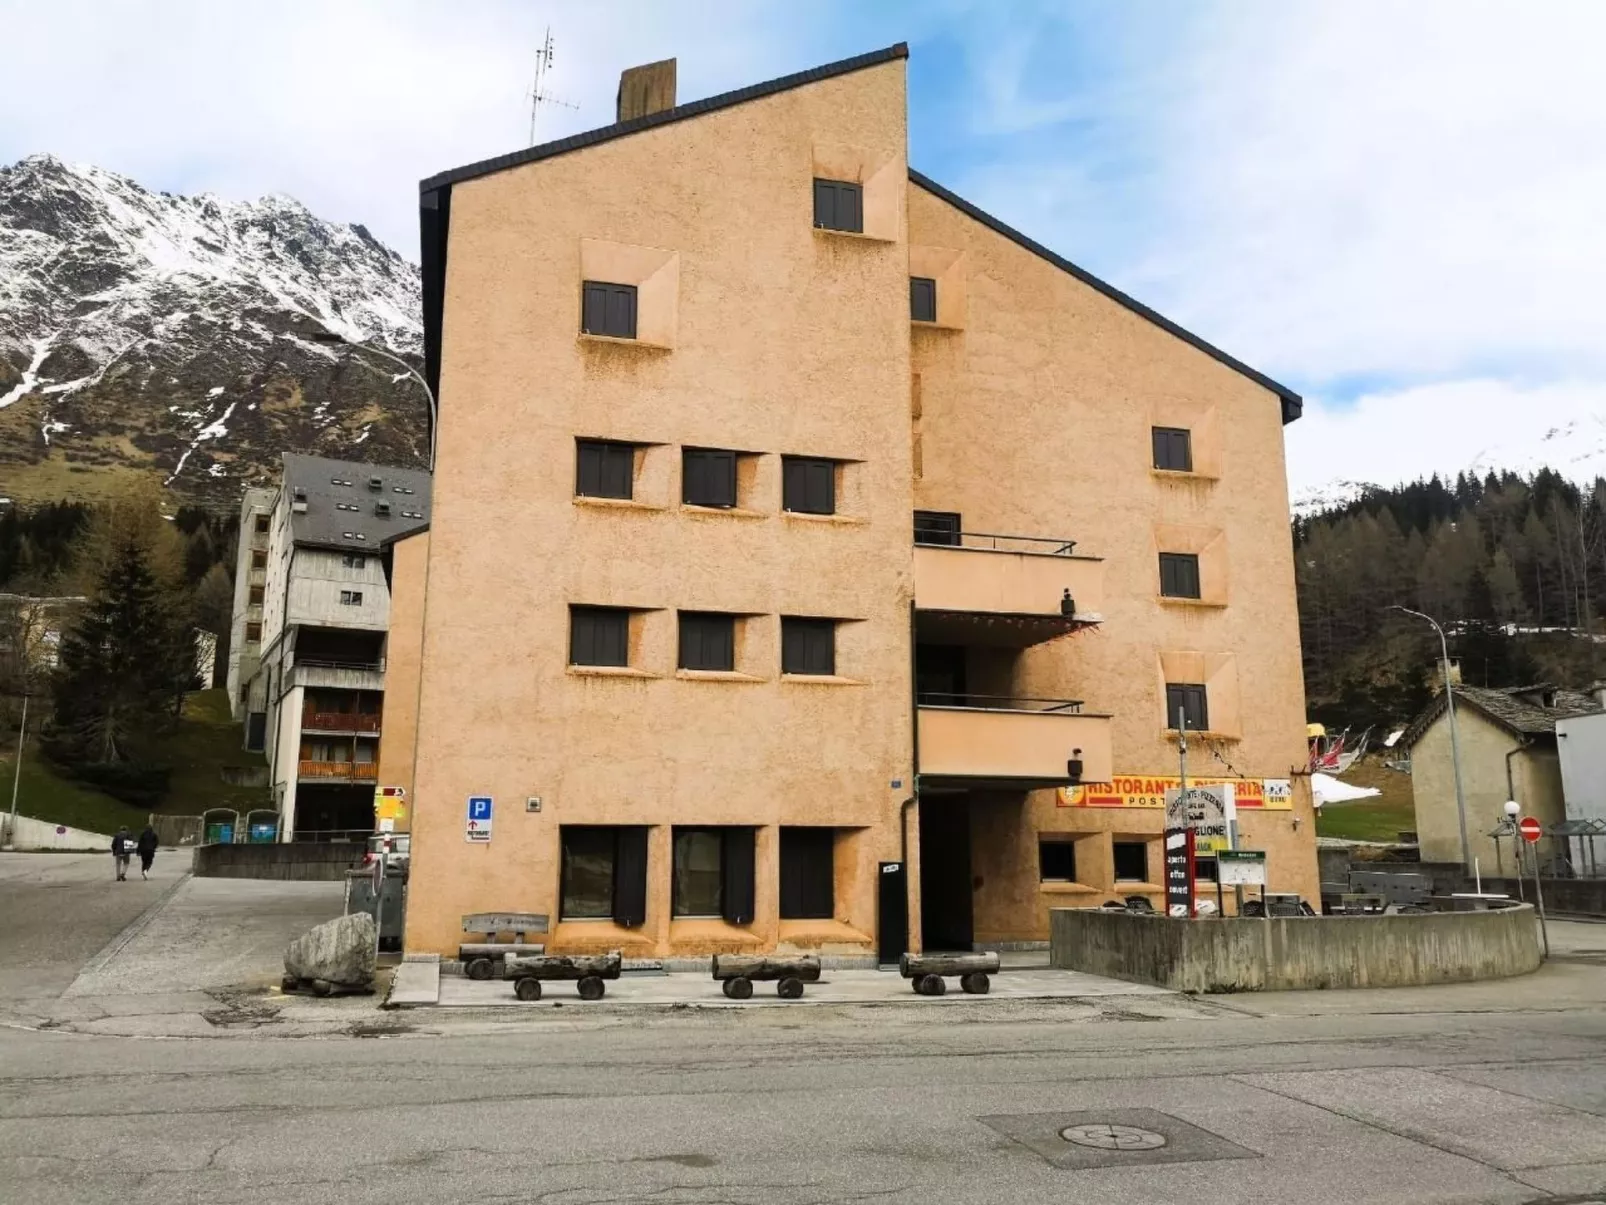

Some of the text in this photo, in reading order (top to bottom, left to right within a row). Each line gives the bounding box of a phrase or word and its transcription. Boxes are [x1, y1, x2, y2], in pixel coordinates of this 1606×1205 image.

[1088, 779, 1181, 795] RISTORANT
[1128, 796, 1165, 805] POST
[475, 801, 486, 816] P
[1194, 825, 1225, 836] GLIONE
